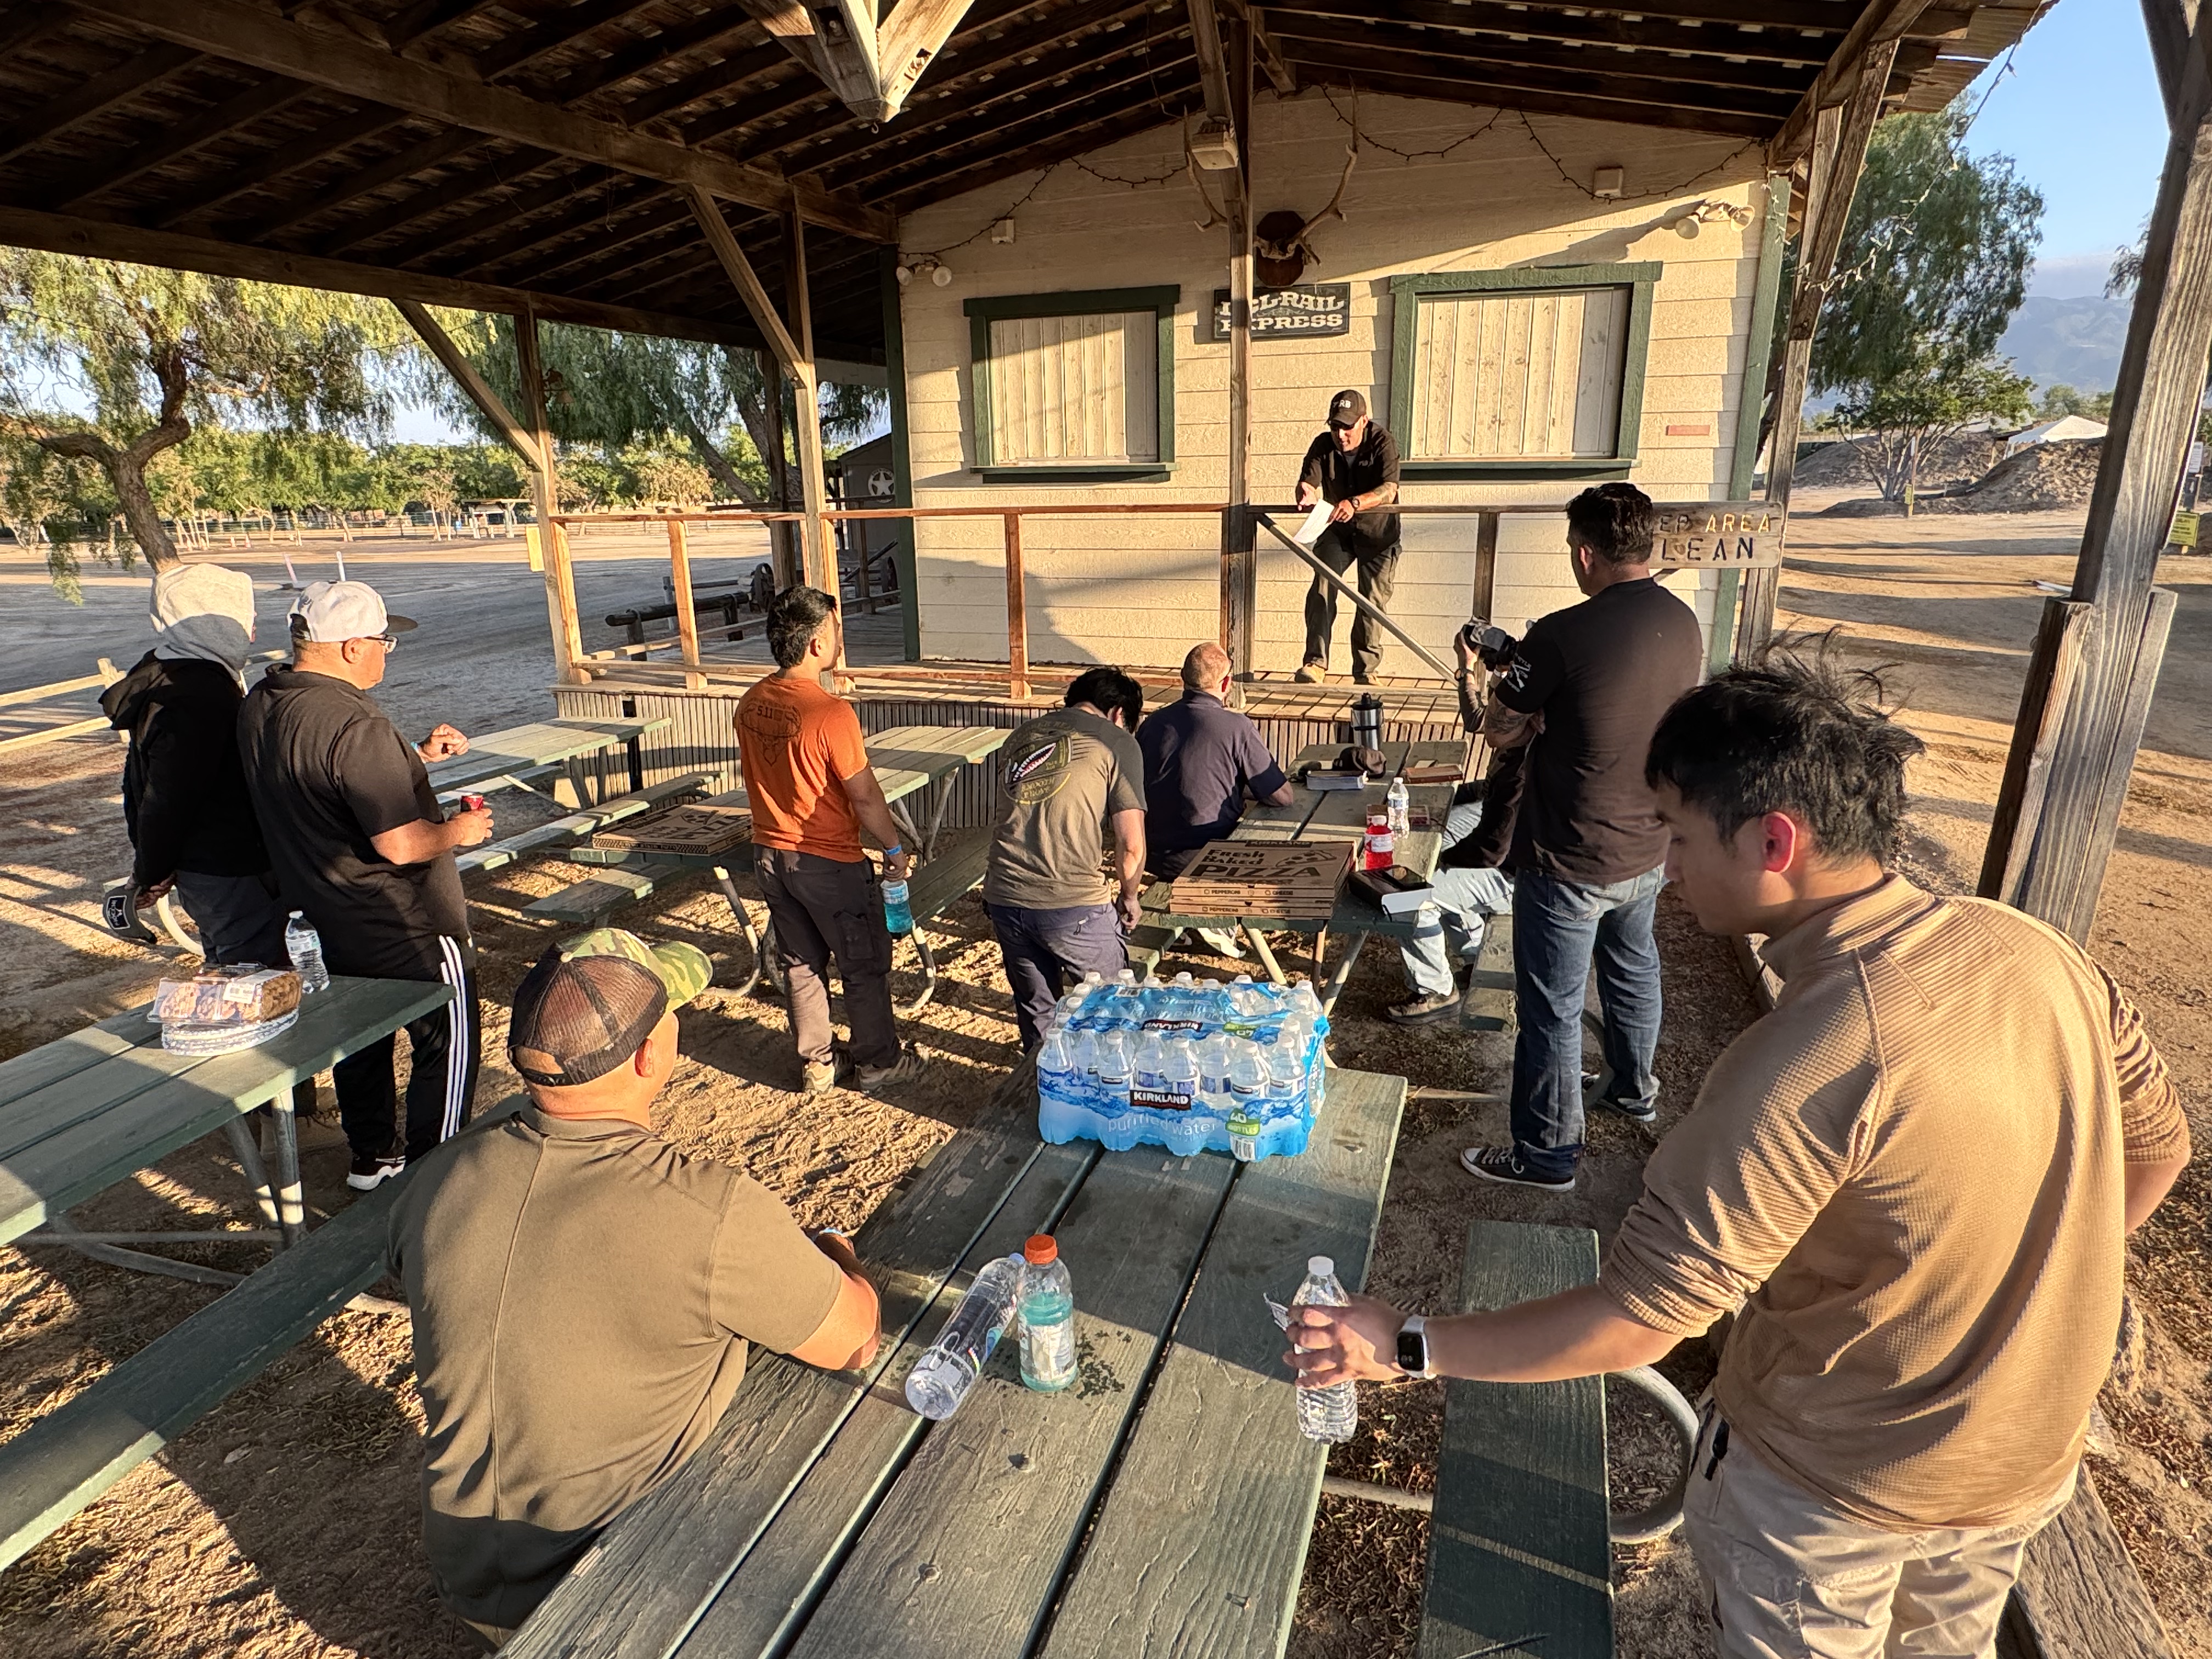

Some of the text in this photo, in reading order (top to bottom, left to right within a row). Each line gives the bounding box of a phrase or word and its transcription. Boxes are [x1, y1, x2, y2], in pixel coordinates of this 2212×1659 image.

[1705, 513, 1771, 533] AREA
[1661, 537, 1753, 561] LEAN
[1189, 864, 1321, 877] PIZZA
[1133, 1091, 1189, 1105] KIRKLAND
[1231, 1112, 1246, 1124] 40
[1172, 1122, 1215, 1136] water
